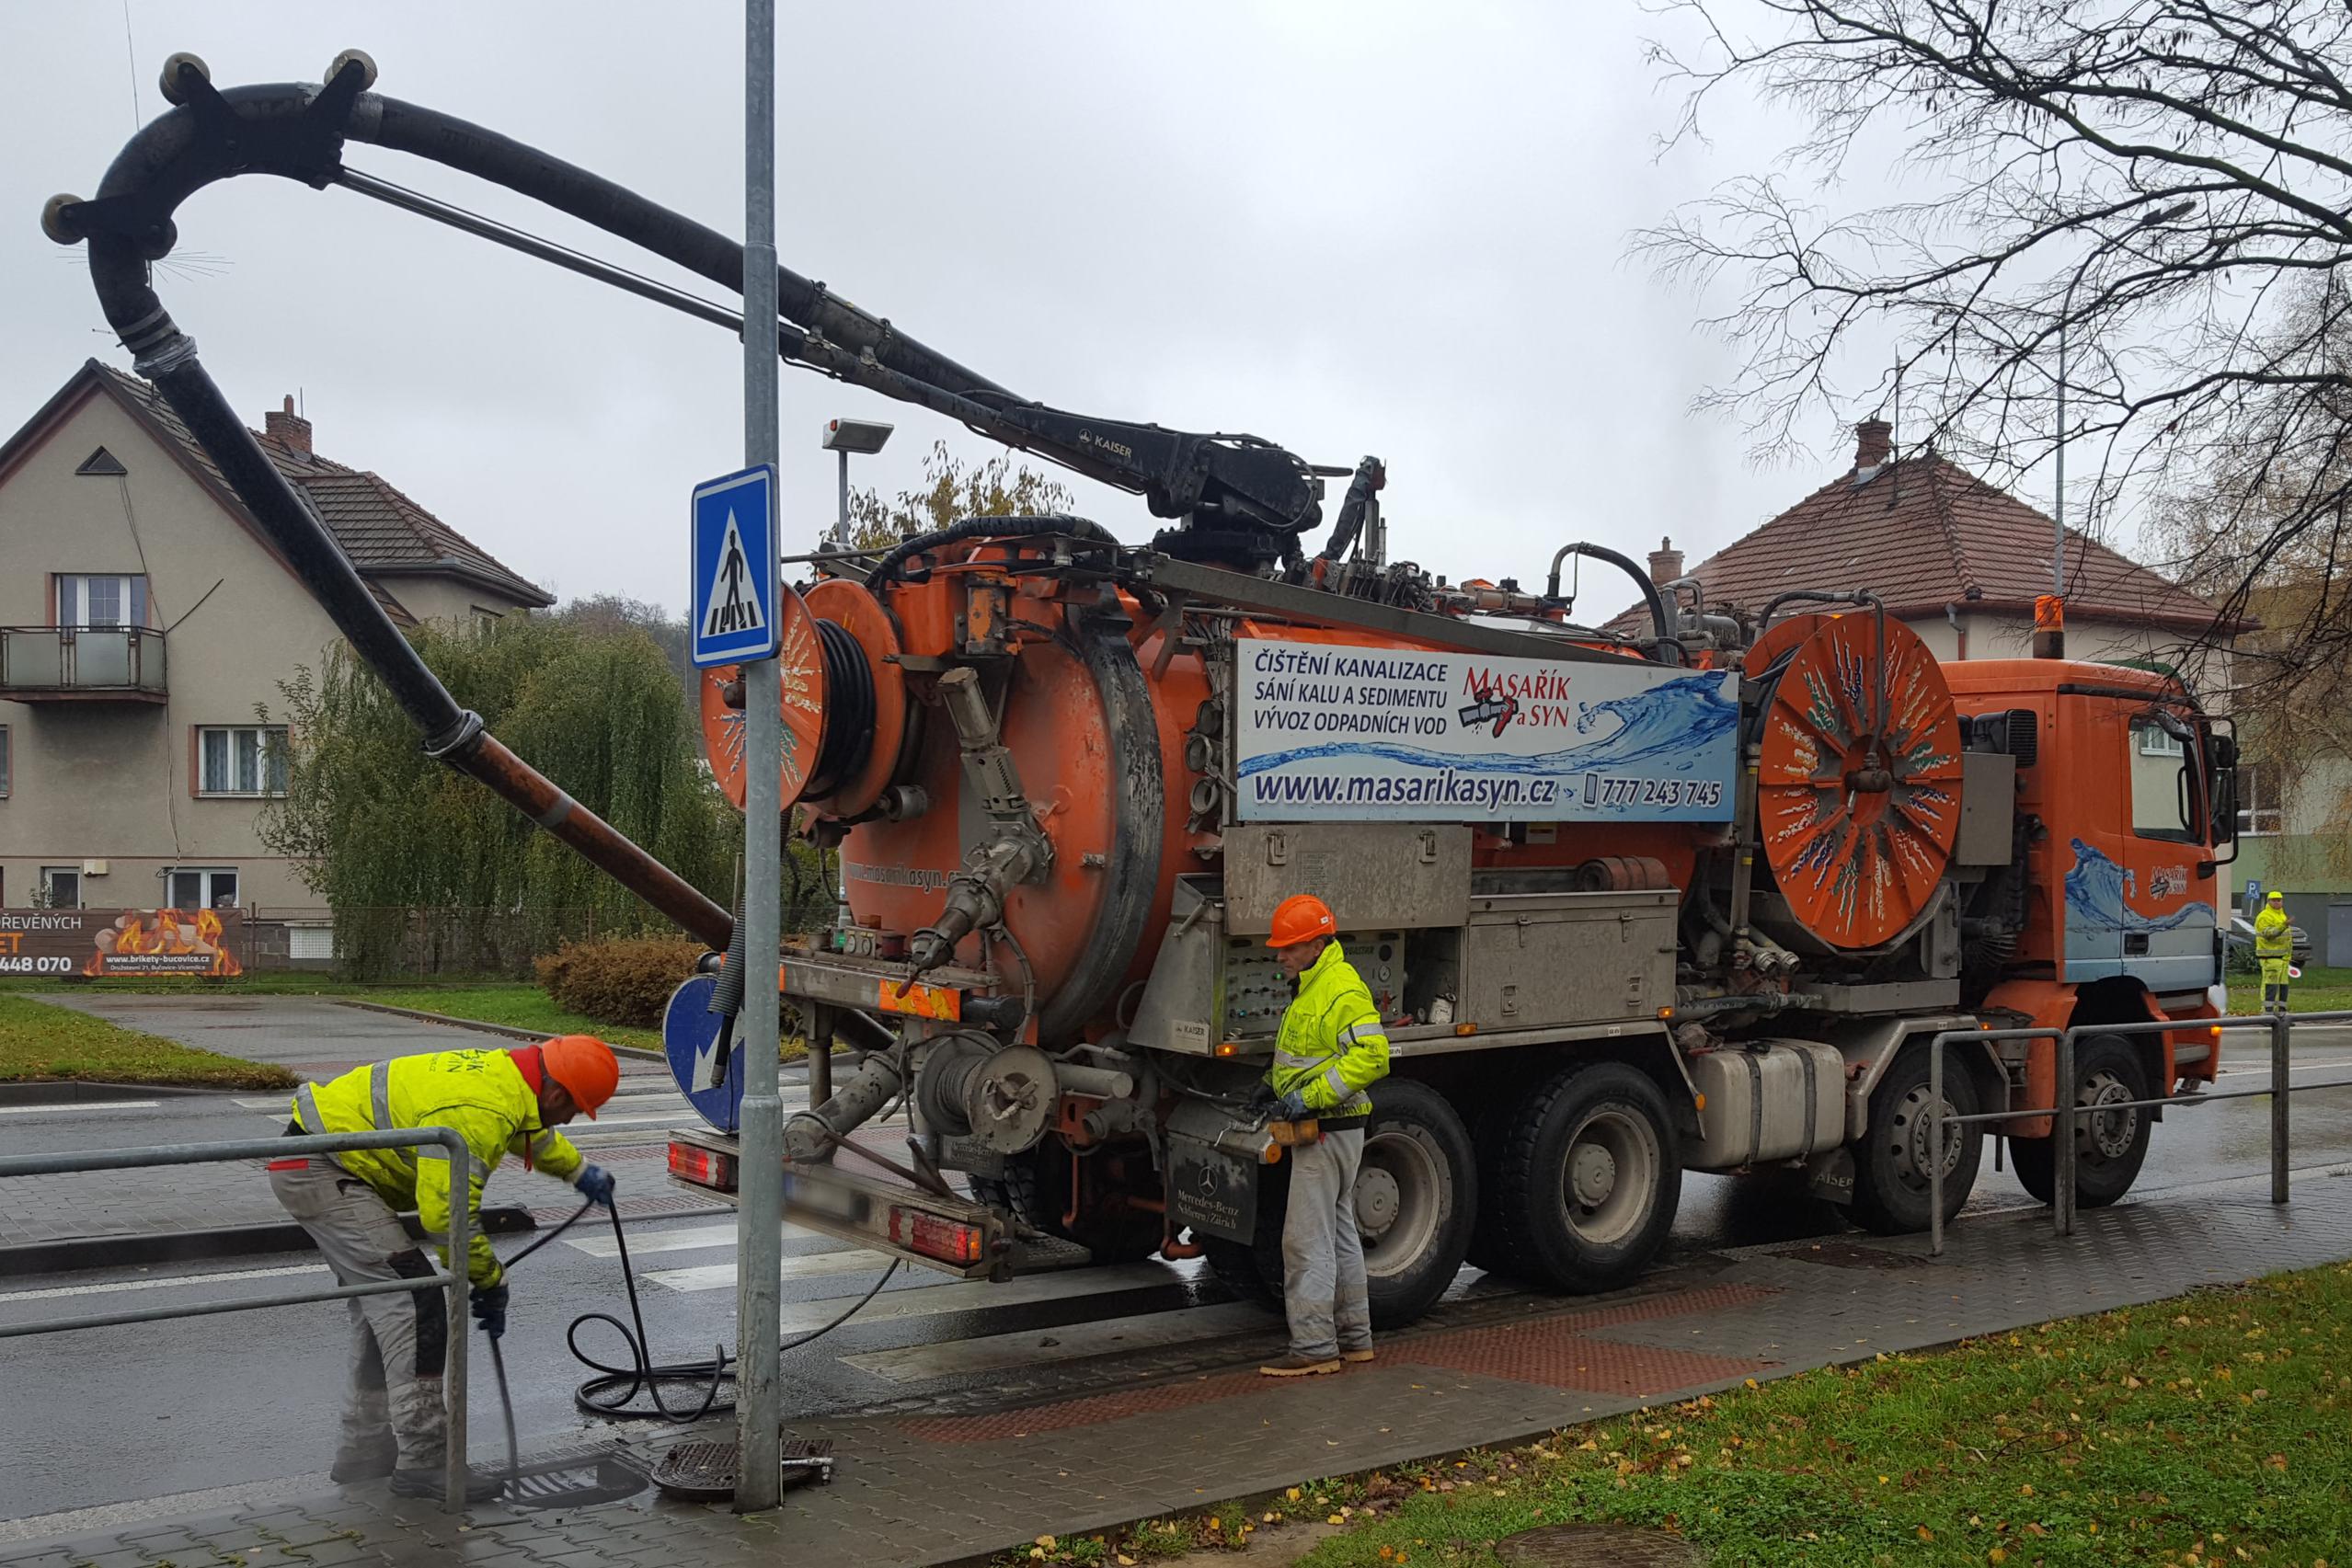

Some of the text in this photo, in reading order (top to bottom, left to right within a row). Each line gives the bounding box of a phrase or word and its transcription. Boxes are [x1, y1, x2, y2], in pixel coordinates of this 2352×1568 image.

[1095, 435, 1131, 458] KAISER
[1255, 648, 1448, 681] ČIŠTĚNÍ KANALIZACE
[1255, 677, 1447, 708] SÁNÍ KALU A SEDIMENTU
[1463, 667, 1571, 700] MASAŘÍK
[1255, 705, 1447, 735] VÝVOZ ODPADNÍCH VOD
[1517, 704, 1569, 727] a SYN
[1255, 770, 1555, 810] www.masarikasyn.cz
[1602, 779, 1721, 807] 777 243 745
[2249, 883, 2256, 895] P
[0, 913, 82, 930] ŘEVĚNÝCH
[0, 956, 72, 972] 448 070
[107, 956, 210, 964] www.brikety-bucovice.cz
[1811, 1171, 1853, 1187] AISER
[1177, 1188, 1239, 1216] Mercedes-Benz
